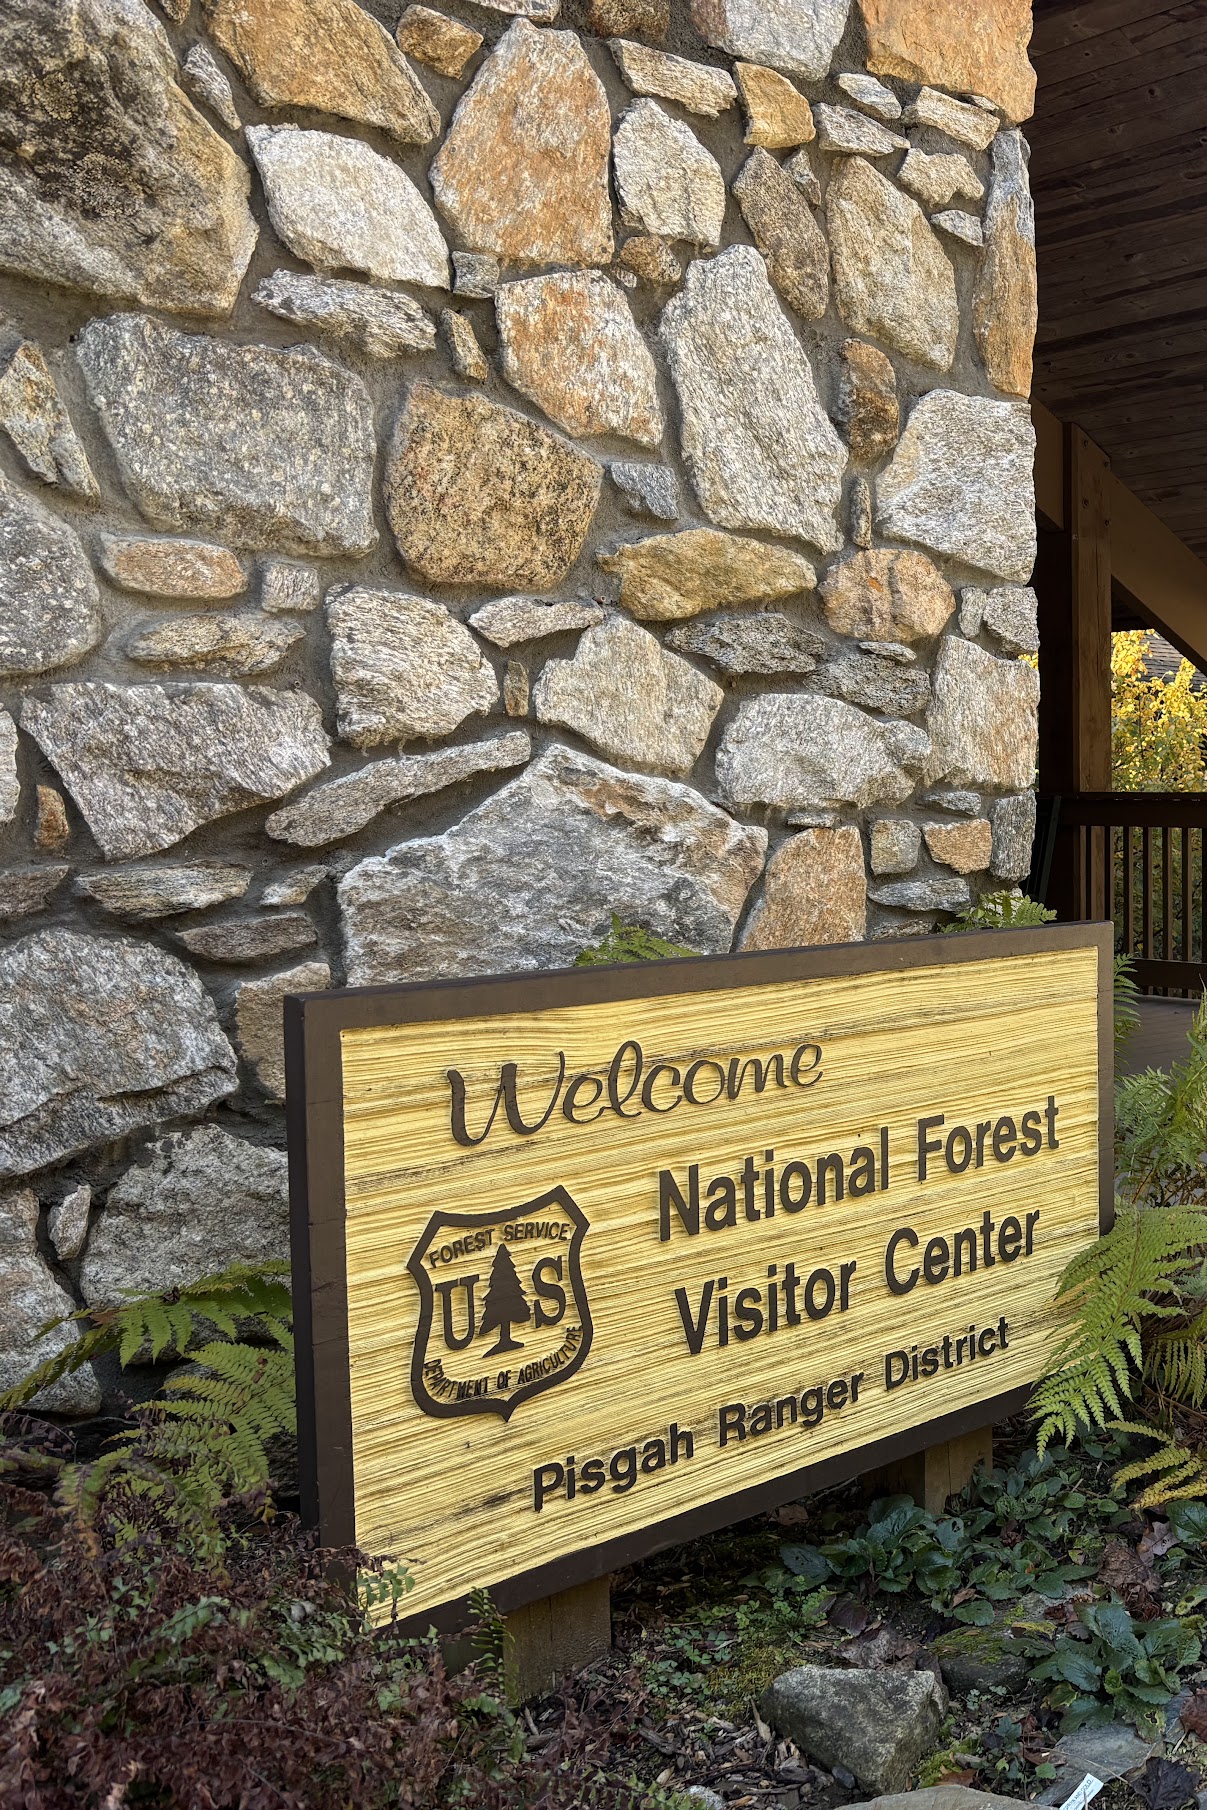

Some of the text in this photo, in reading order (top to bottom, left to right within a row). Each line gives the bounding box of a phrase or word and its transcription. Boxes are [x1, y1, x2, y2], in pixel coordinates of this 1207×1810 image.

[447, 1040, 824, 1147] Welcome
[658, 1095, 1060, 1242] National Forest
[428, 1221, 571, 1269] FOREST SERVICE
[674, 1209, 1040, 1356] Visitor Center
[423, 1324, 584, 1400] DEPARTMENT OF AGRICULTURE
[533, 1316, 1010, 1514] Pisgah Ranger District
